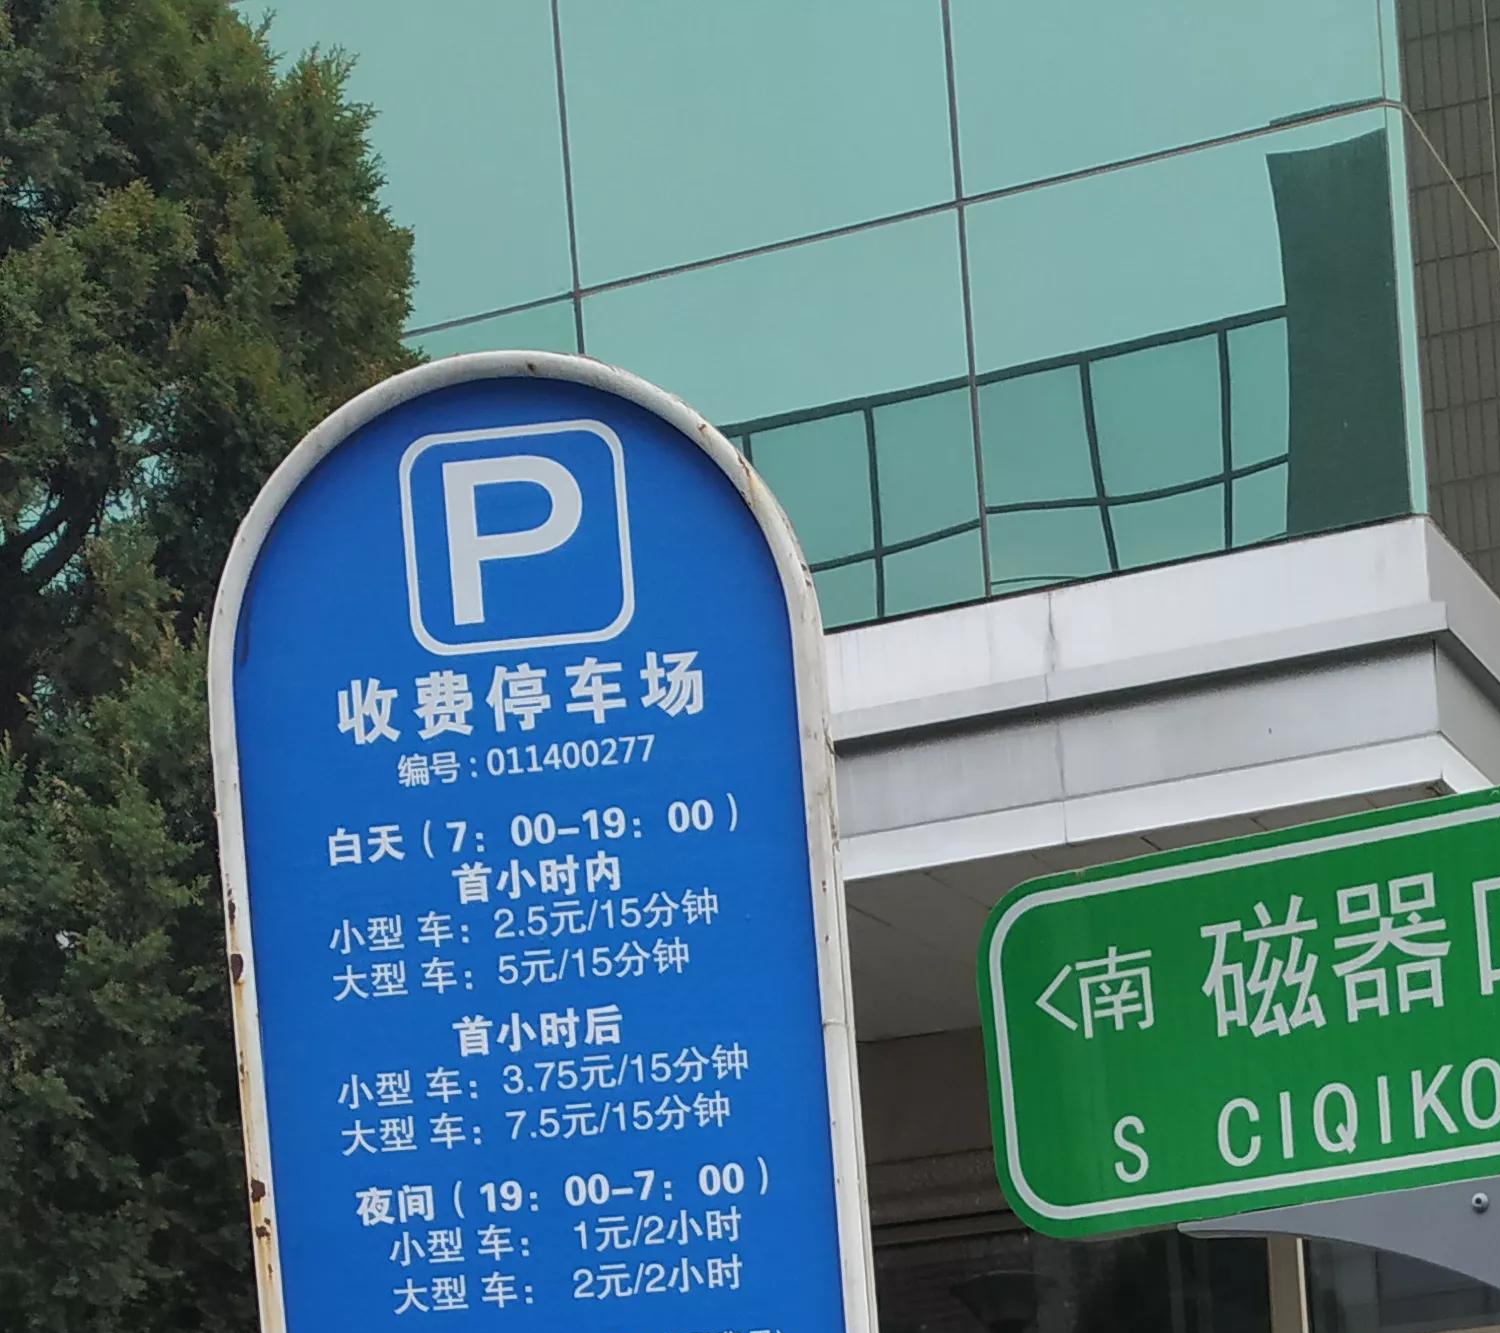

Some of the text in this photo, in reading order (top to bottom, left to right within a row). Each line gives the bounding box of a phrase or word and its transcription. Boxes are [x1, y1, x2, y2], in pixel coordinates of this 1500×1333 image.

[442, 454, 583, 626] P
[337, 651, 704, 745] 收费停车场
[451, 851, 621, 904] 首小时内
[452, 1004, 623, 1057] 首小时后
[1075, 946, 1154, 1039] 南
[1114, 1115, 1149, 1183] S
